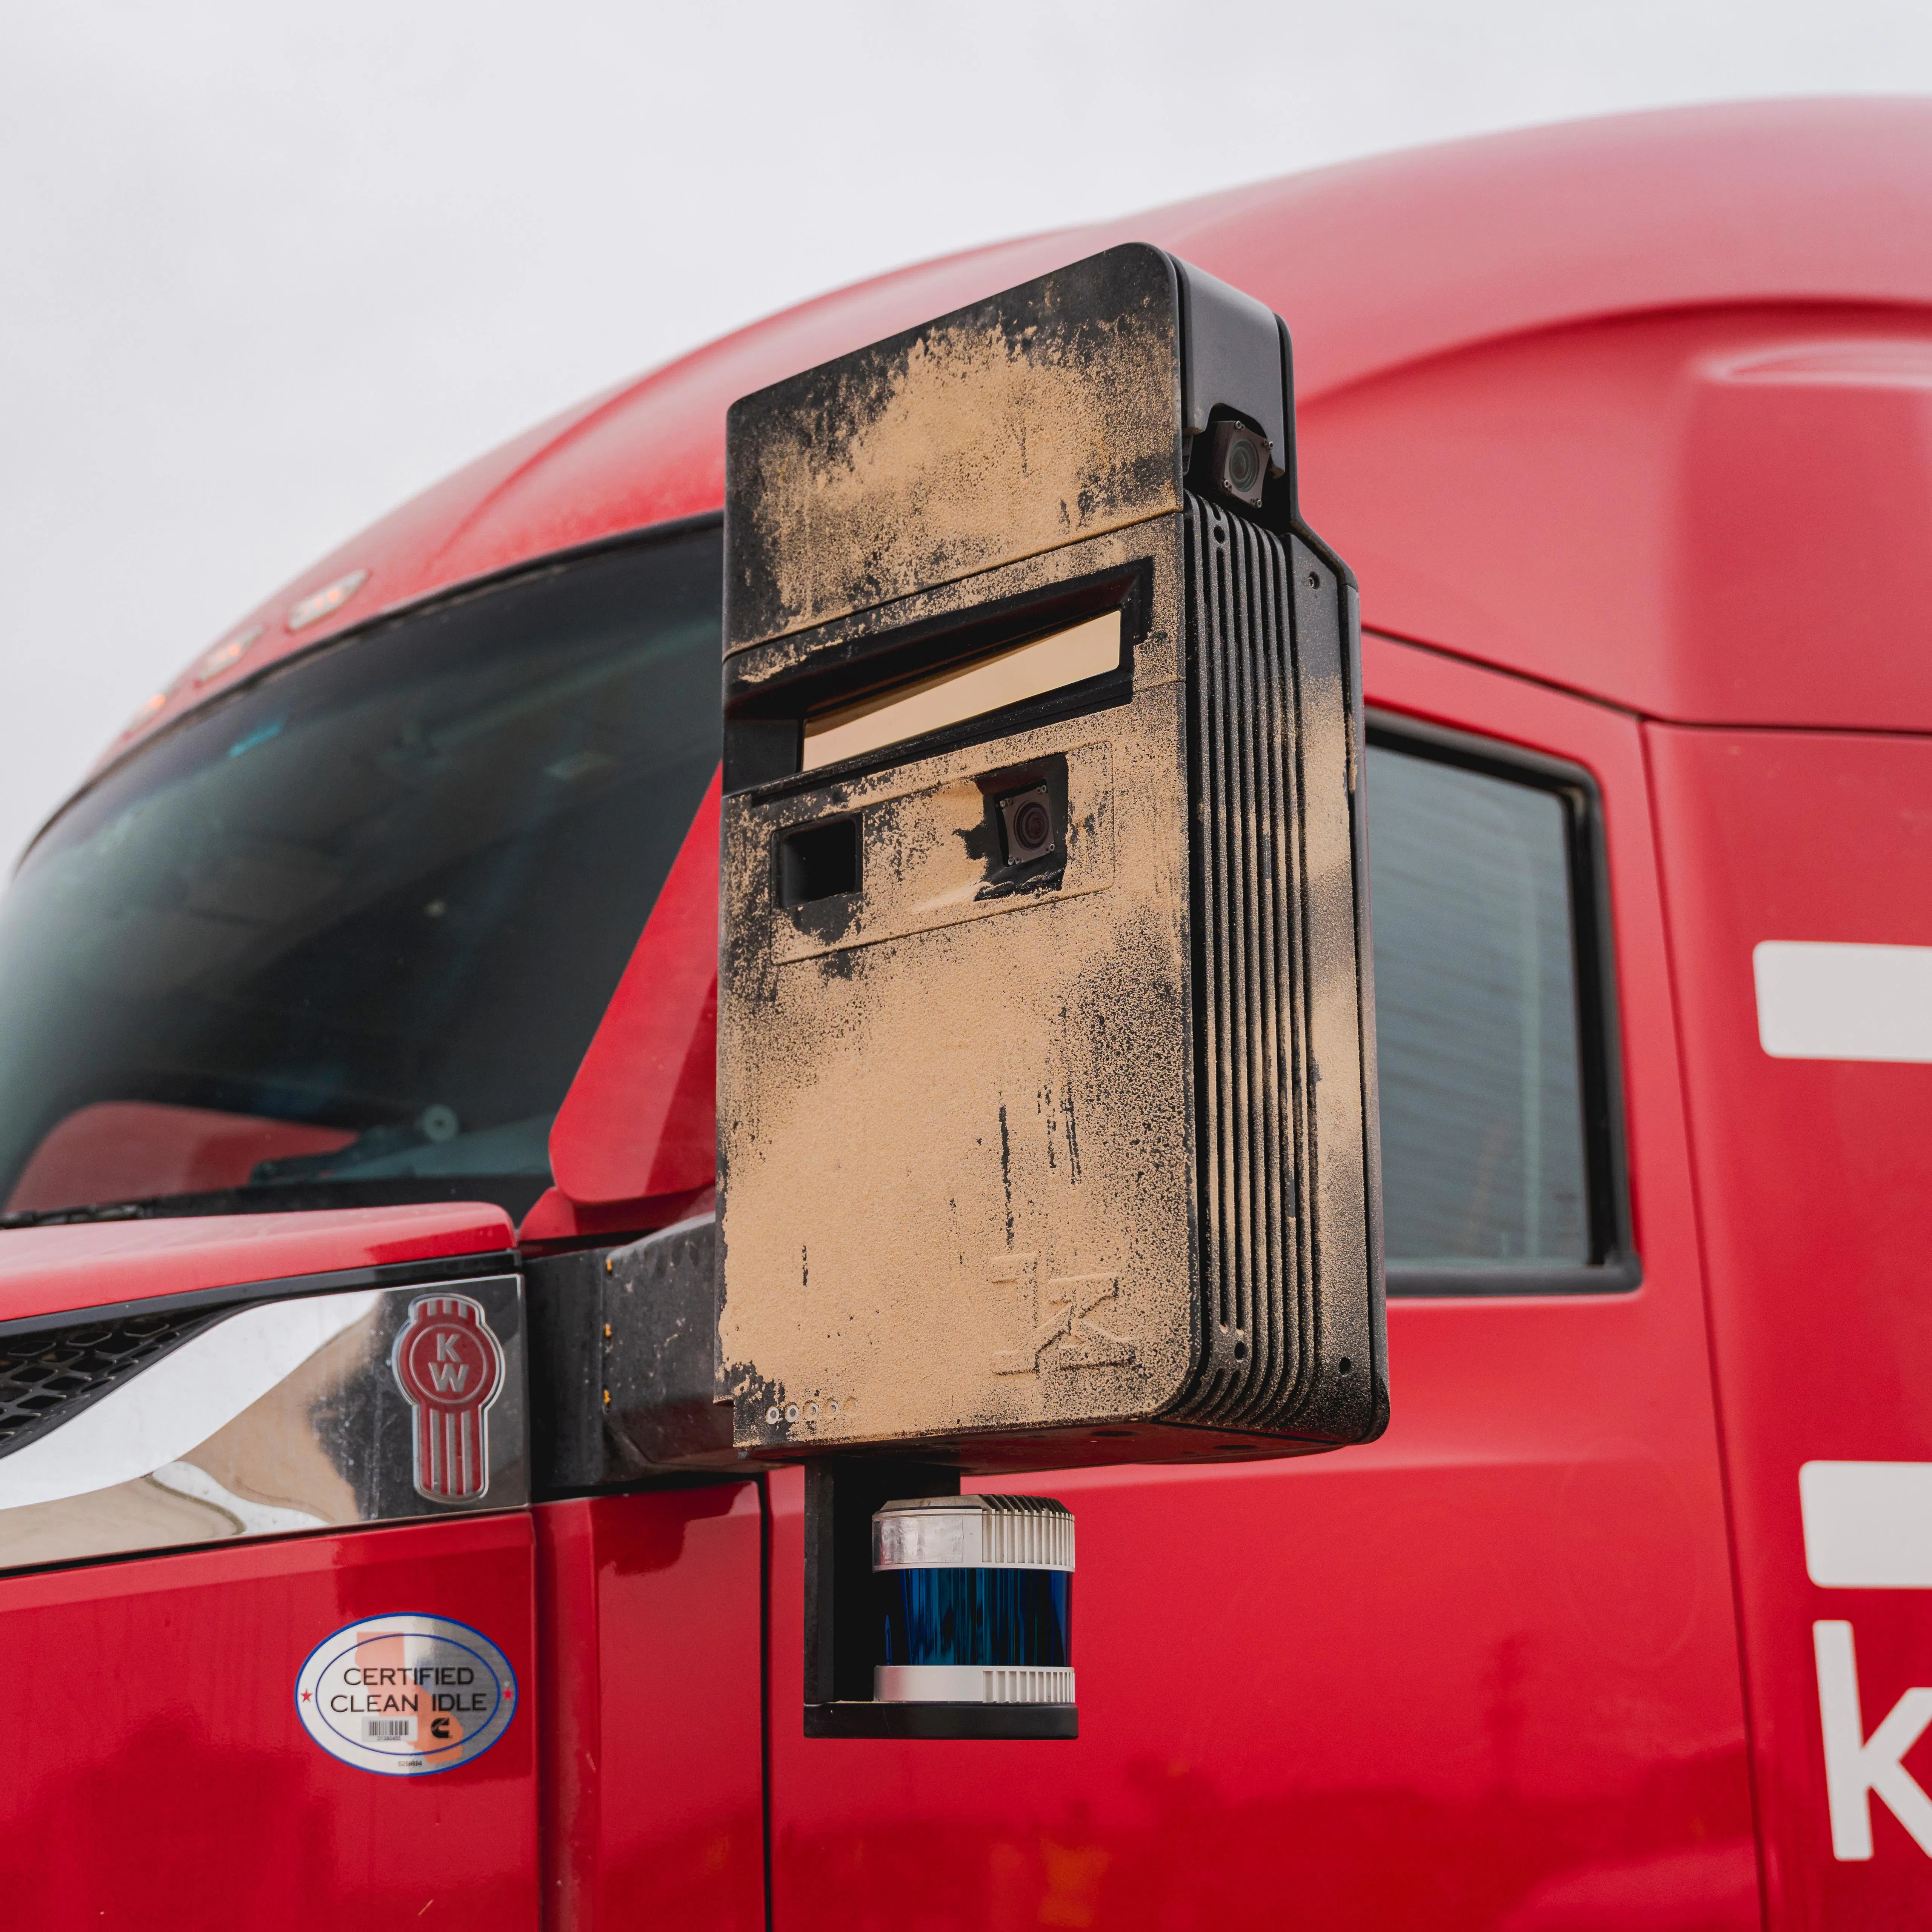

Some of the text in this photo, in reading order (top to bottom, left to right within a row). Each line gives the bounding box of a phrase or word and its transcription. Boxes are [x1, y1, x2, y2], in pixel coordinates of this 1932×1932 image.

[436, 1332, 461, 1363] K
[428, 1362, 469, 1392] W
[344, 1667, 474, 1686] CERTIFIED
[331, 1693, 487, 1712] CLEAN IDLE
